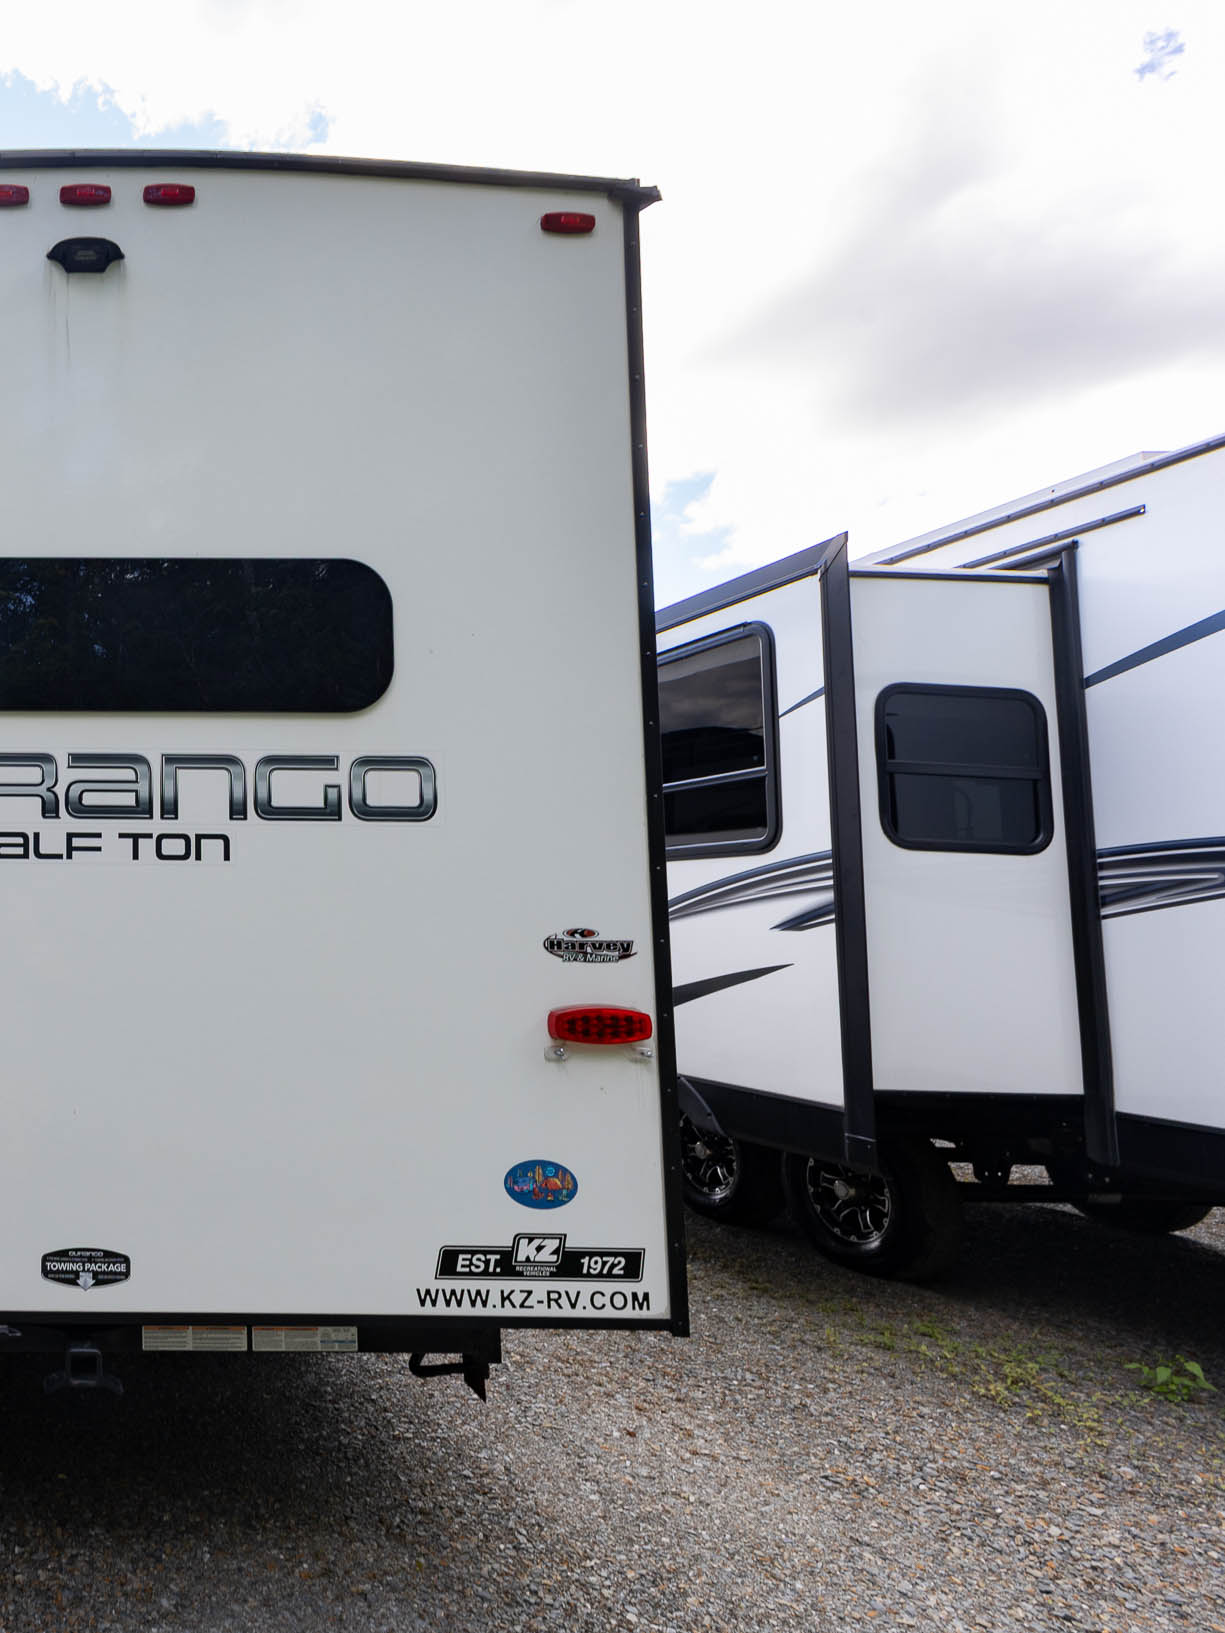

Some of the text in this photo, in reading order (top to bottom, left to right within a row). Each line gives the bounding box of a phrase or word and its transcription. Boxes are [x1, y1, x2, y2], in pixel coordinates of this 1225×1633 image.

[118, 832, 231, 862] TON
[548, 939, 634, 954] Harvey
[562, 952, 620, 963] RV & Marine
[516, 1238, 561, 1263] KZ
[45, 1262, 127, 1272] TOWING PACKAGE
[456, 1254, 502, 1273] EST.
[580, 1256, 626, 1275] 1972
[416, 1288, 651, 1311] WWW.KZ-RV.COM
